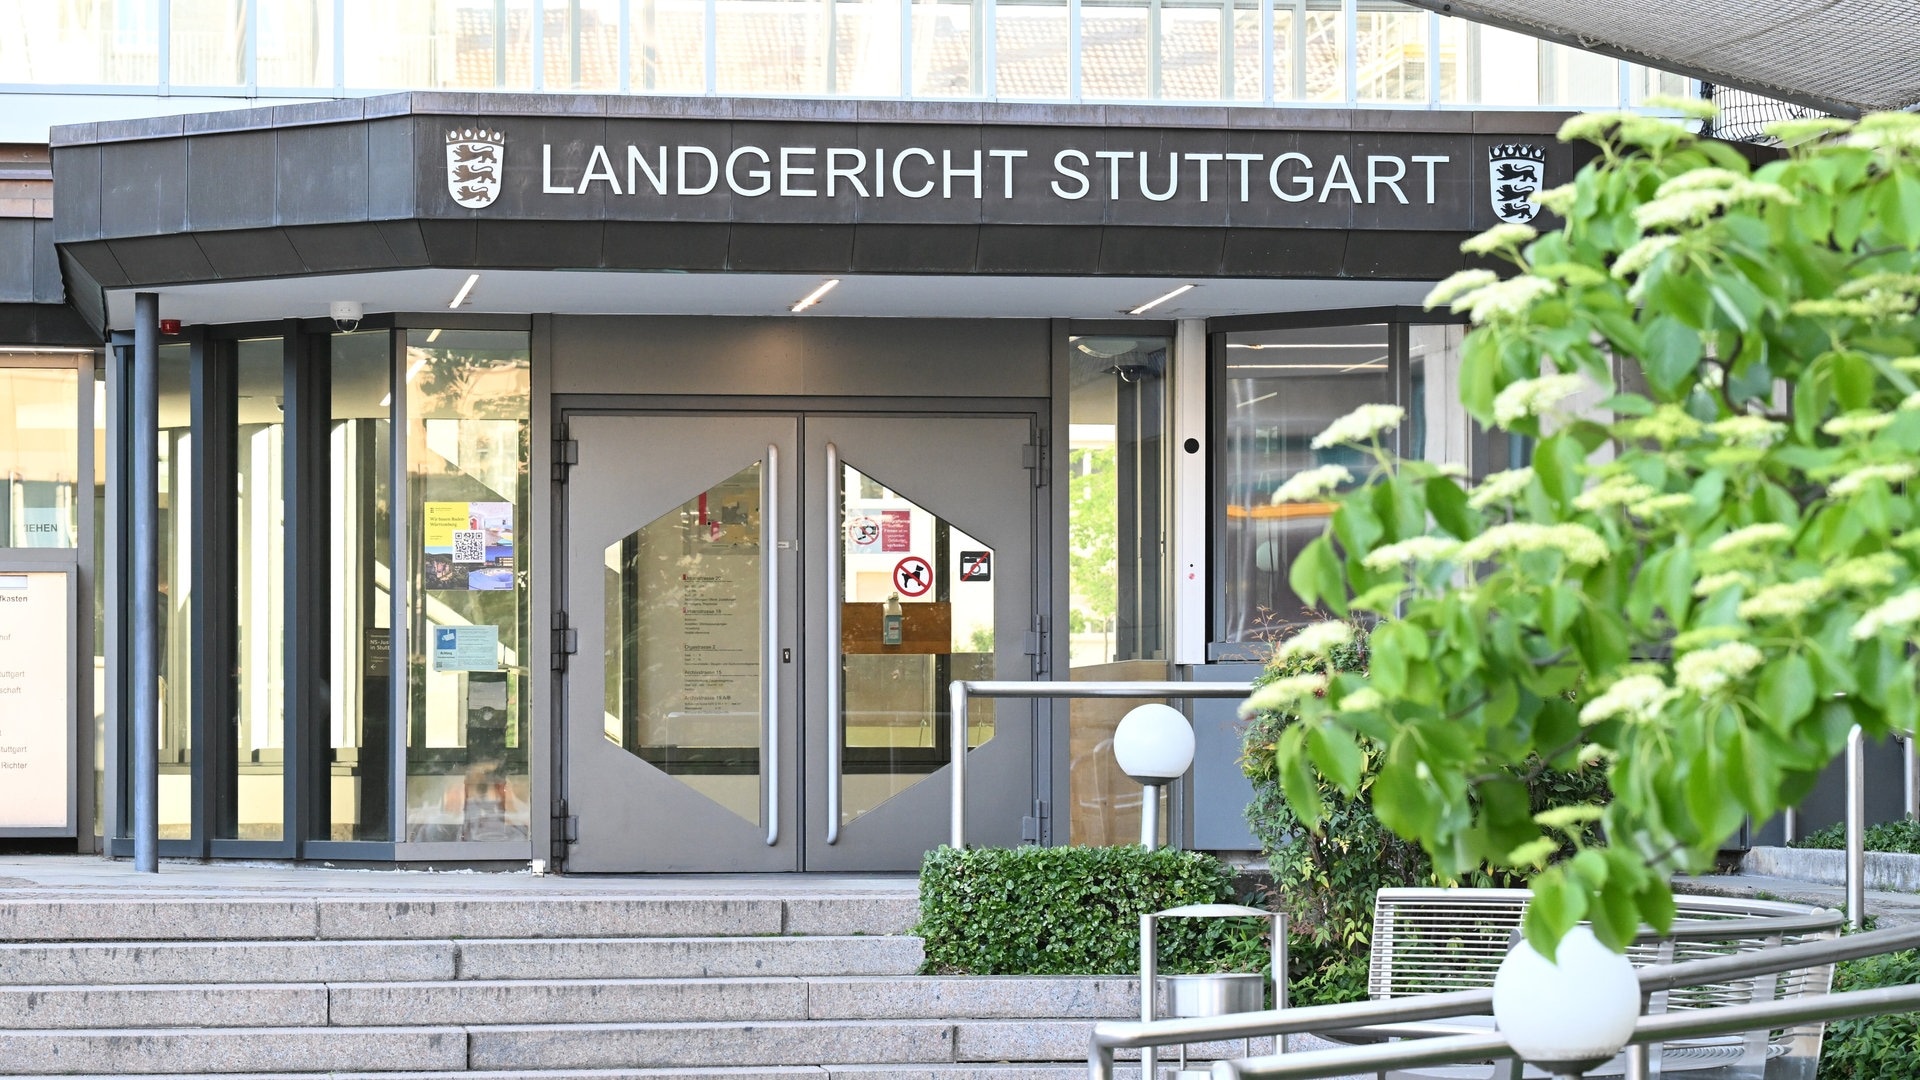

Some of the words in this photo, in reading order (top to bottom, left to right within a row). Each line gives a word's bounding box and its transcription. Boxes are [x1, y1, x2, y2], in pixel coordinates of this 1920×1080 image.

[541, 143, 1028, 200] LANDGERICHT
[1050, 149, 1450, 205] STUTTGART
[1, 761, 28, 769] Richter
